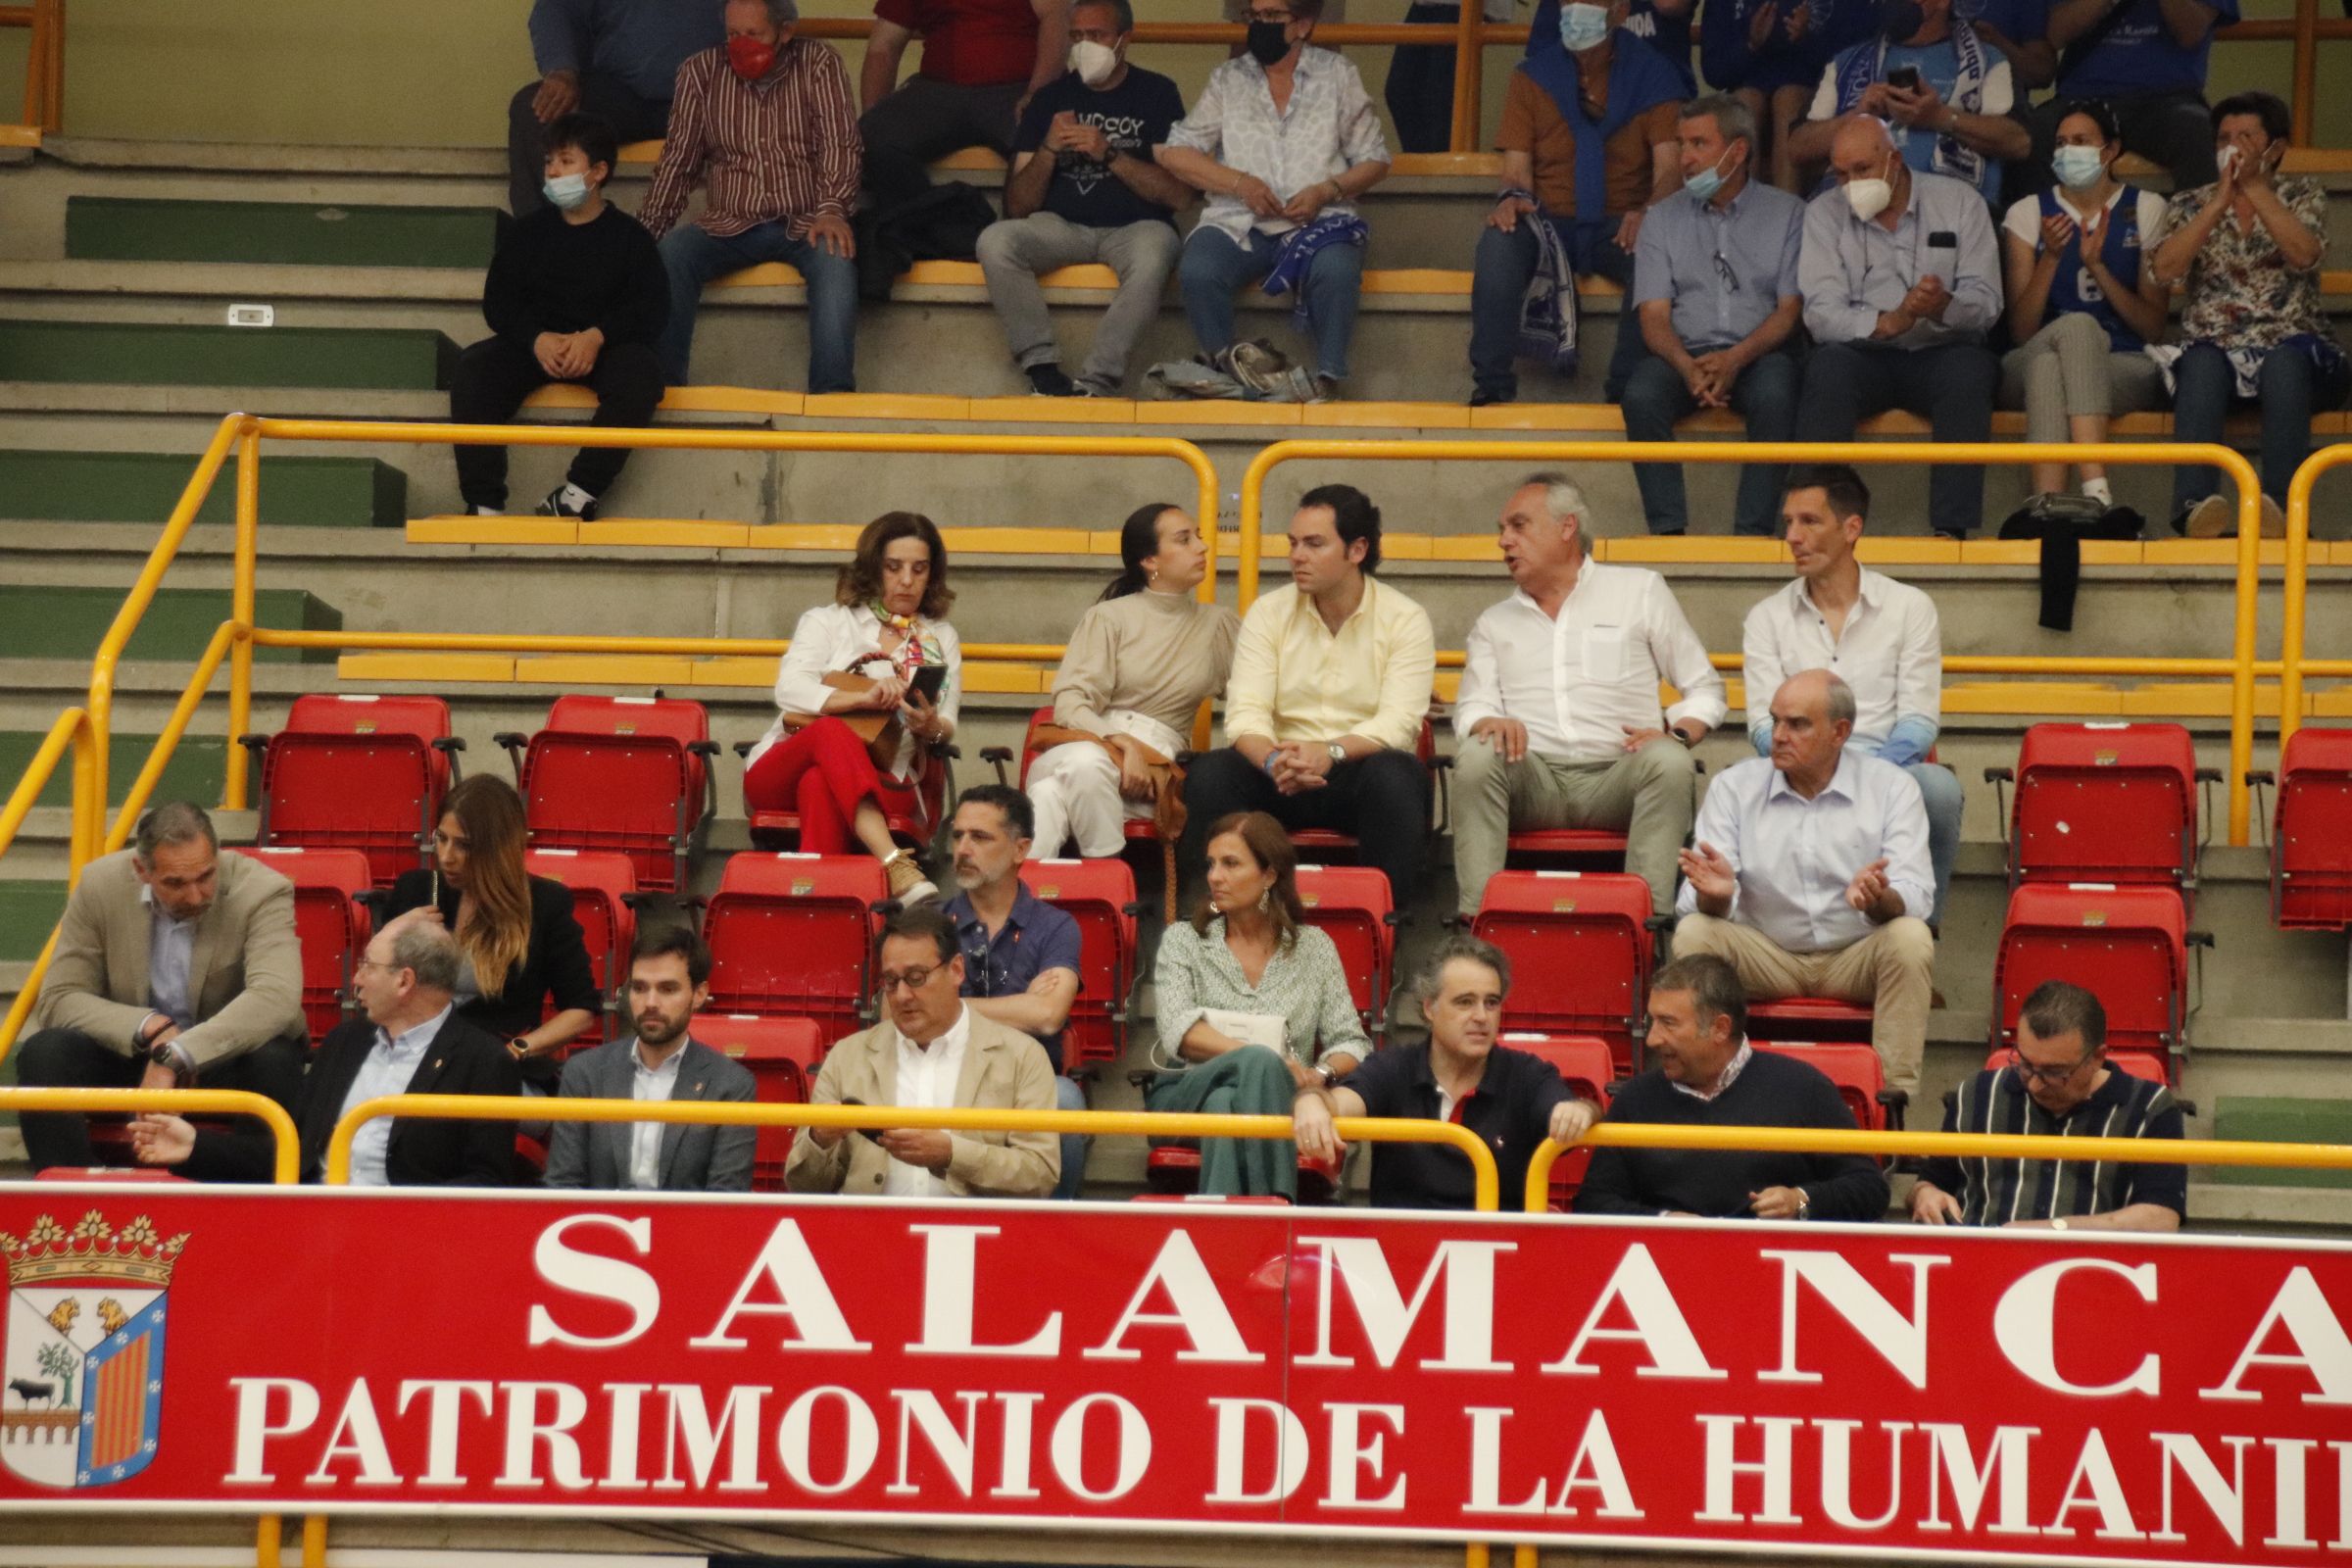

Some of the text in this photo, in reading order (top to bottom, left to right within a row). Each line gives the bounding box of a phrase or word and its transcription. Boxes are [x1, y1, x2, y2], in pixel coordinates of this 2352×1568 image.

[527, 1212, 2352, 1406] SALAMANCA
[222, 1376, 2352, 1550] PATRIMONIO DE LA HUMANI
